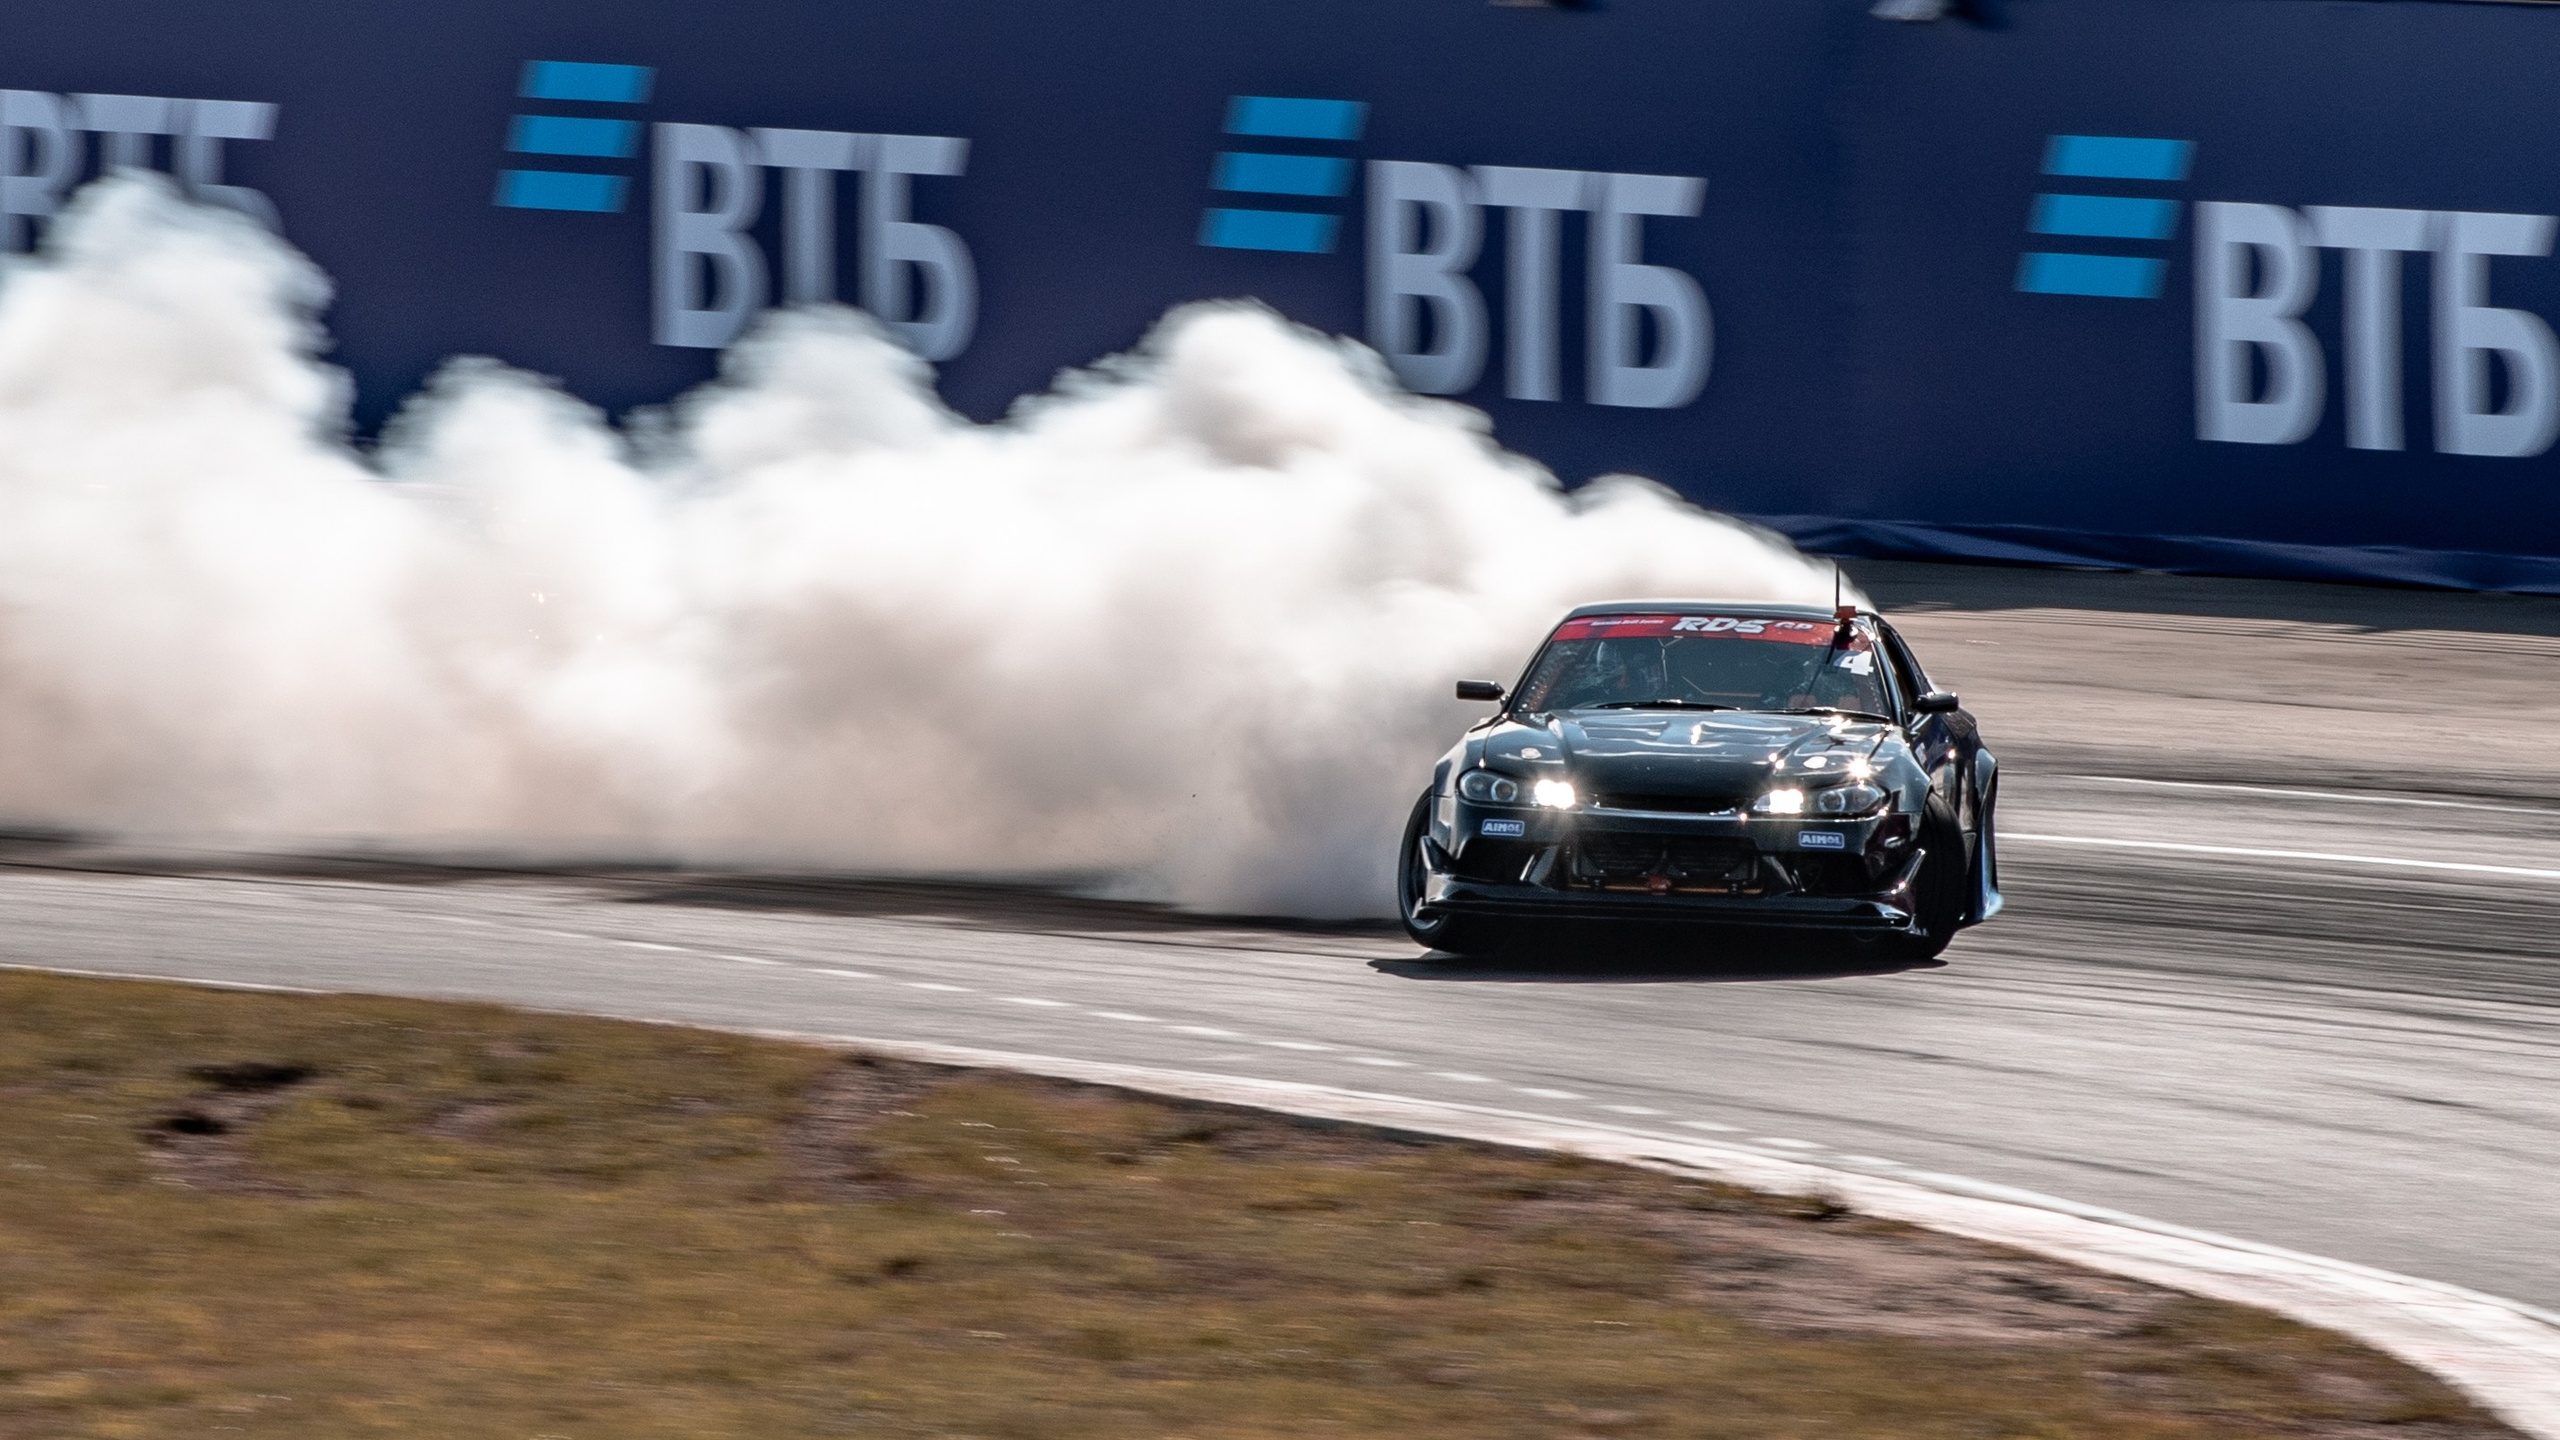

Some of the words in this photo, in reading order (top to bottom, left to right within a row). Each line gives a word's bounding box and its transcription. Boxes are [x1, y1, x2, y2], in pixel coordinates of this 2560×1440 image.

[650, 121, 979, 361] ВТБ
[1364, 159, 1714, 409] ВТБ
[2193, 200, 2560, 458] ВТБ
[1671, 616, 1775, 634] RDS
[1834, 650, 1874, 676] 4
[1484, 822, 1522, 833] AIMOL
[1801, 835, 1842, 845] AIMOL
